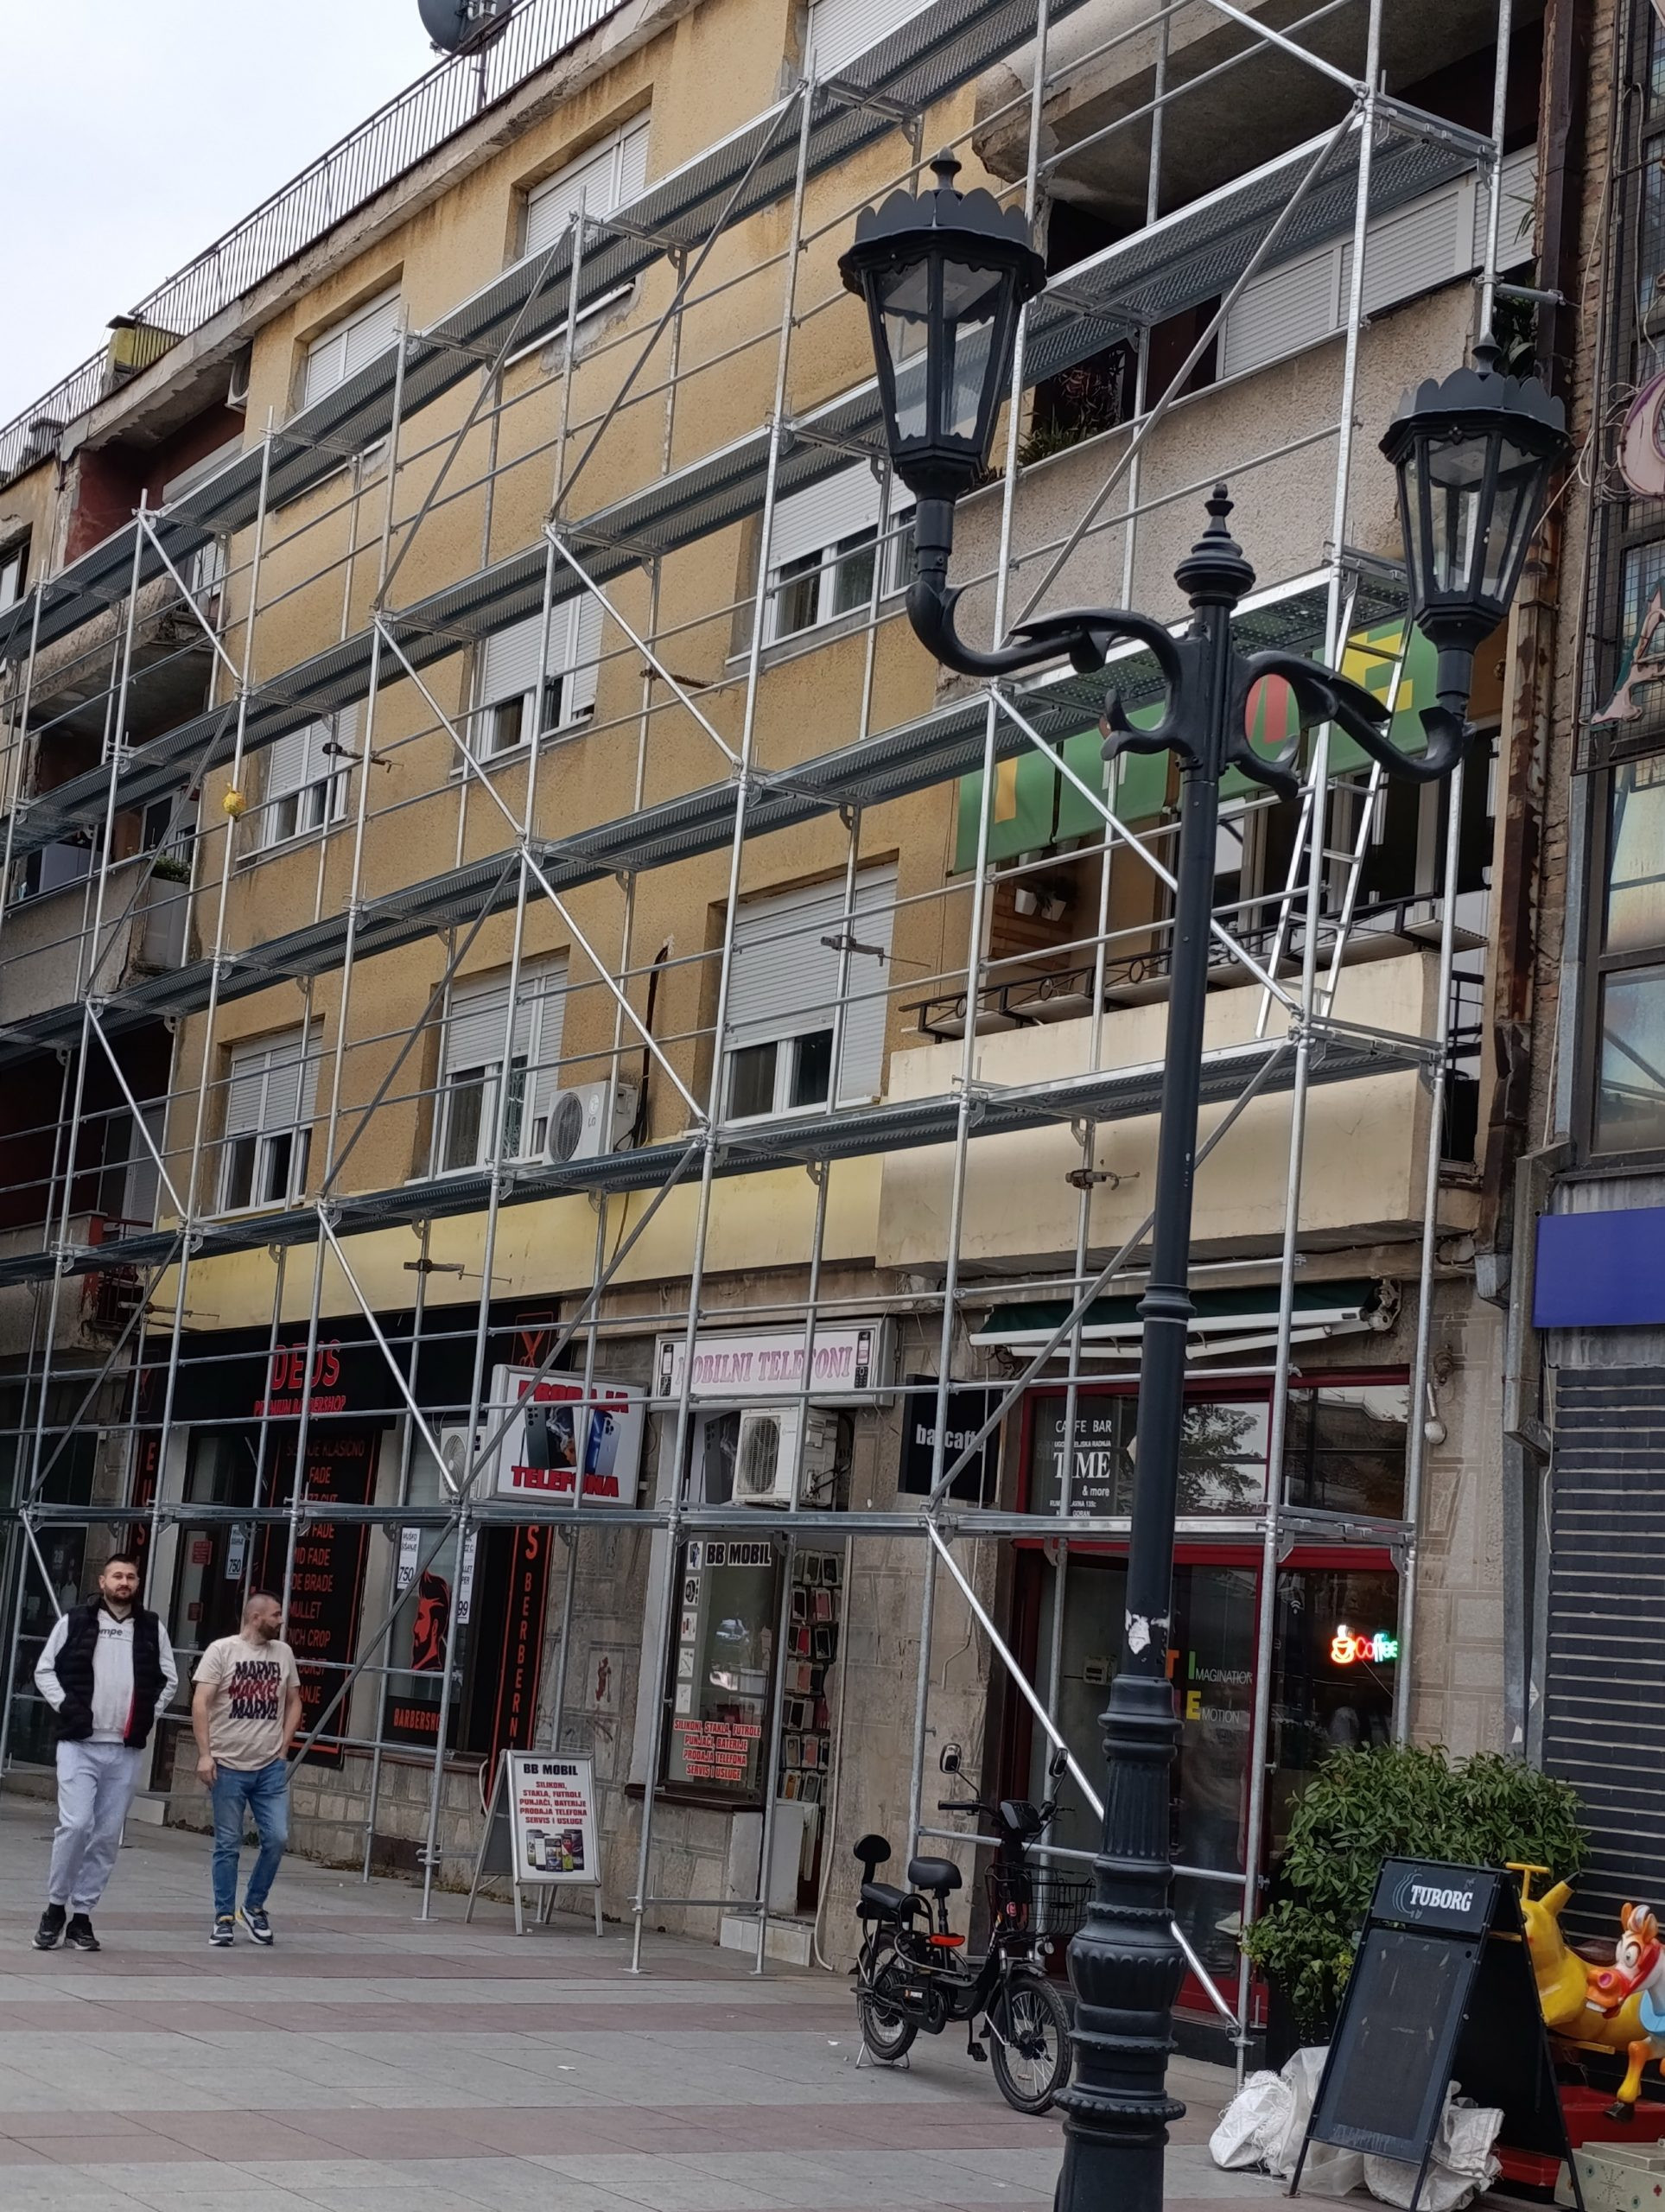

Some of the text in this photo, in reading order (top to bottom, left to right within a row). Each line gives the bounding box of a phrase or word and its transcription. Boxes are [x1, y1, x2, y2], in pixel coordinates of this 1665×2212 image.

[588, 1117, 596, 1128] LG
[758, 1346, 853, 1382] TELEONI
[293, 1395, 346, 1414] BABERSHOP
[1055, 1420, 1112, 1433] CAFE BAR
[1053, 1452, 1111, 1478] TME
[309, 1466, 333, 1484] FADE
[1090, 1487, 1110, 1497] more
[312, 1523, 335, 1540] FADE
[308, 1548, 333, 1567] FADE
[707, 1543, 772, 1565] BB MOBIL
[229, 1559, 242, 1573] 750
[304, 1573, 334, 1593] BRADE
[398, 1567, 415, 1583] 750
[307, 1628, 332, 1648] CROP
[1355, 1633, 1398, 1662] Coffee
[1186, 1689, 1240, 1723] EMOTION
[733, 1724, 761, 1738] FUTROLE
[717, 1738, 748, 1751] BATERIJE
[683, 1749, 747, 1766] PRODAJA TELEFONA
[524, 1764, 578, 1776] BB MOBIL
[686, 1764, 710, 1777] SERVIS
[715, 1767, 741, 1781] USLUGE
[523, 1789, 550, 1798] STAKLA,
[536, 1781, 567, 1790] SILIKONI,
[1410, 1885, 1474, 1912] TUBORG
